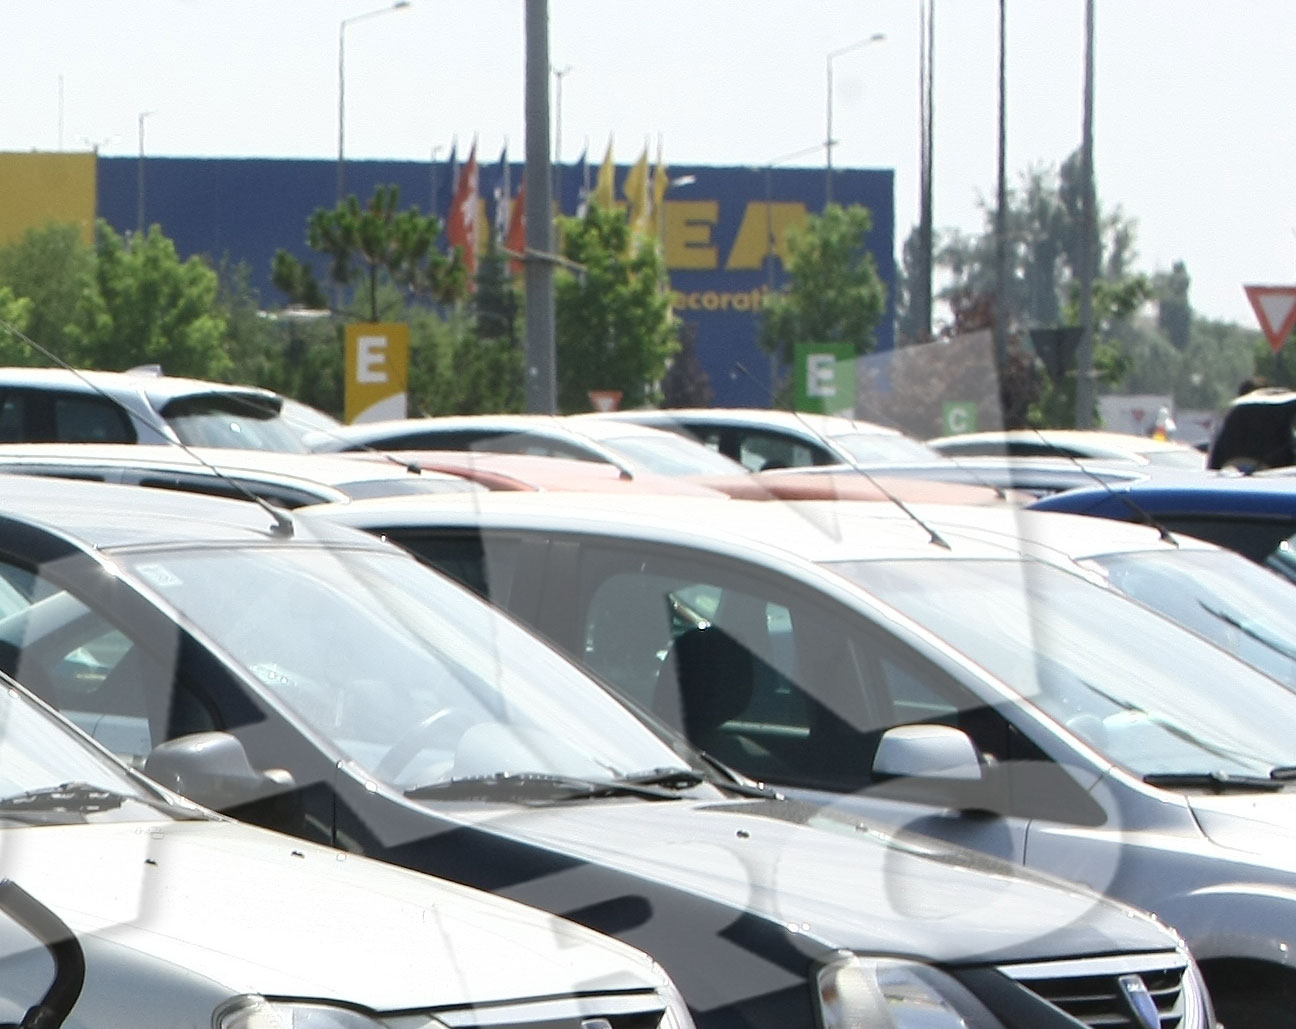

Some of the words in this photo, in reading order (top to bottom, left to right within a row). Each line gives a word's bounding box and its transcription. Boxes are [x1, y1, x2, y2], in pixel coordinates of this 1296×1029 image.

[356, 336, 387, 383] E
[806, 354, 835, 396] E
[947, 408, 967, 432] C
